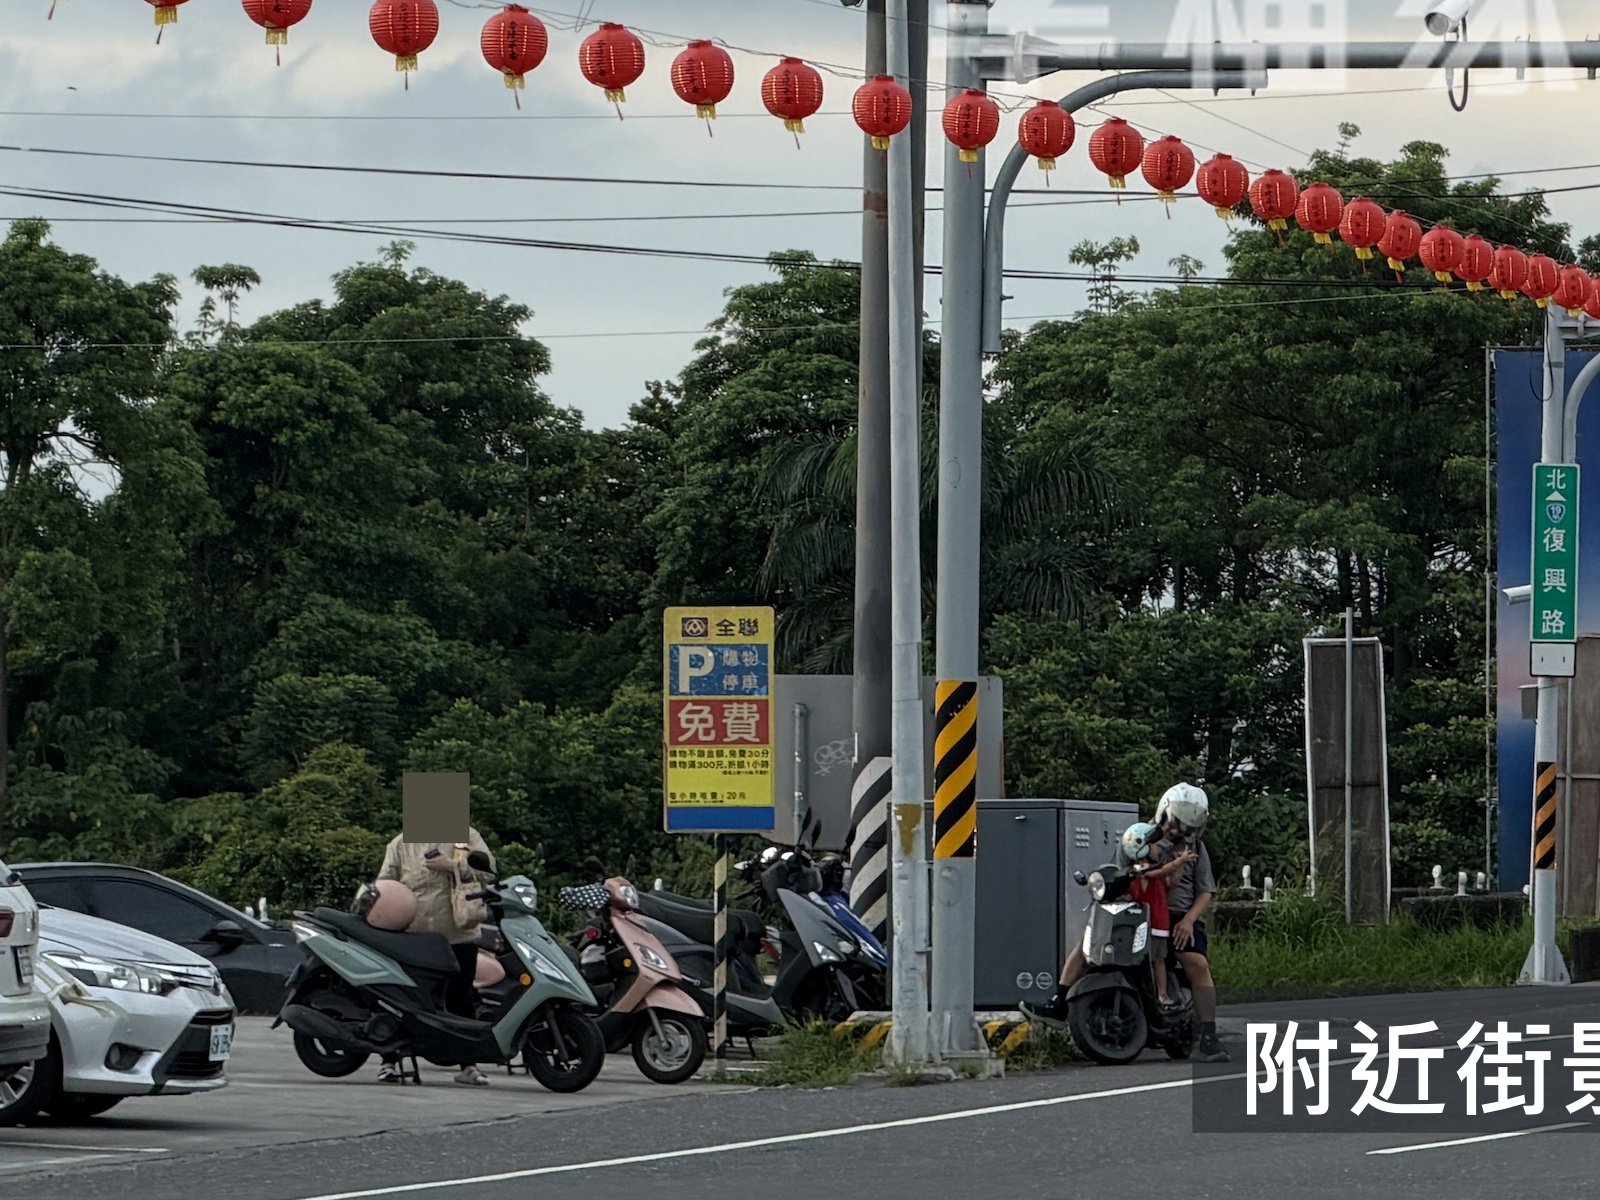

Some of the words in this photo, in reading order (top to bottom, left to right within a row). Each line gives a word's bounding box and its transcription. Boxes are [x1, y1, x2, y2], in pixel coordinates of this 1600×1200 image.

[1546, 468, 1567, 490] 北
[1541, 527, 1567, 635] 復興路
[715, 618, 759, 637] 全聯
[678, 645, 715, 693] P
[677, 702, 760, 743] 免費
